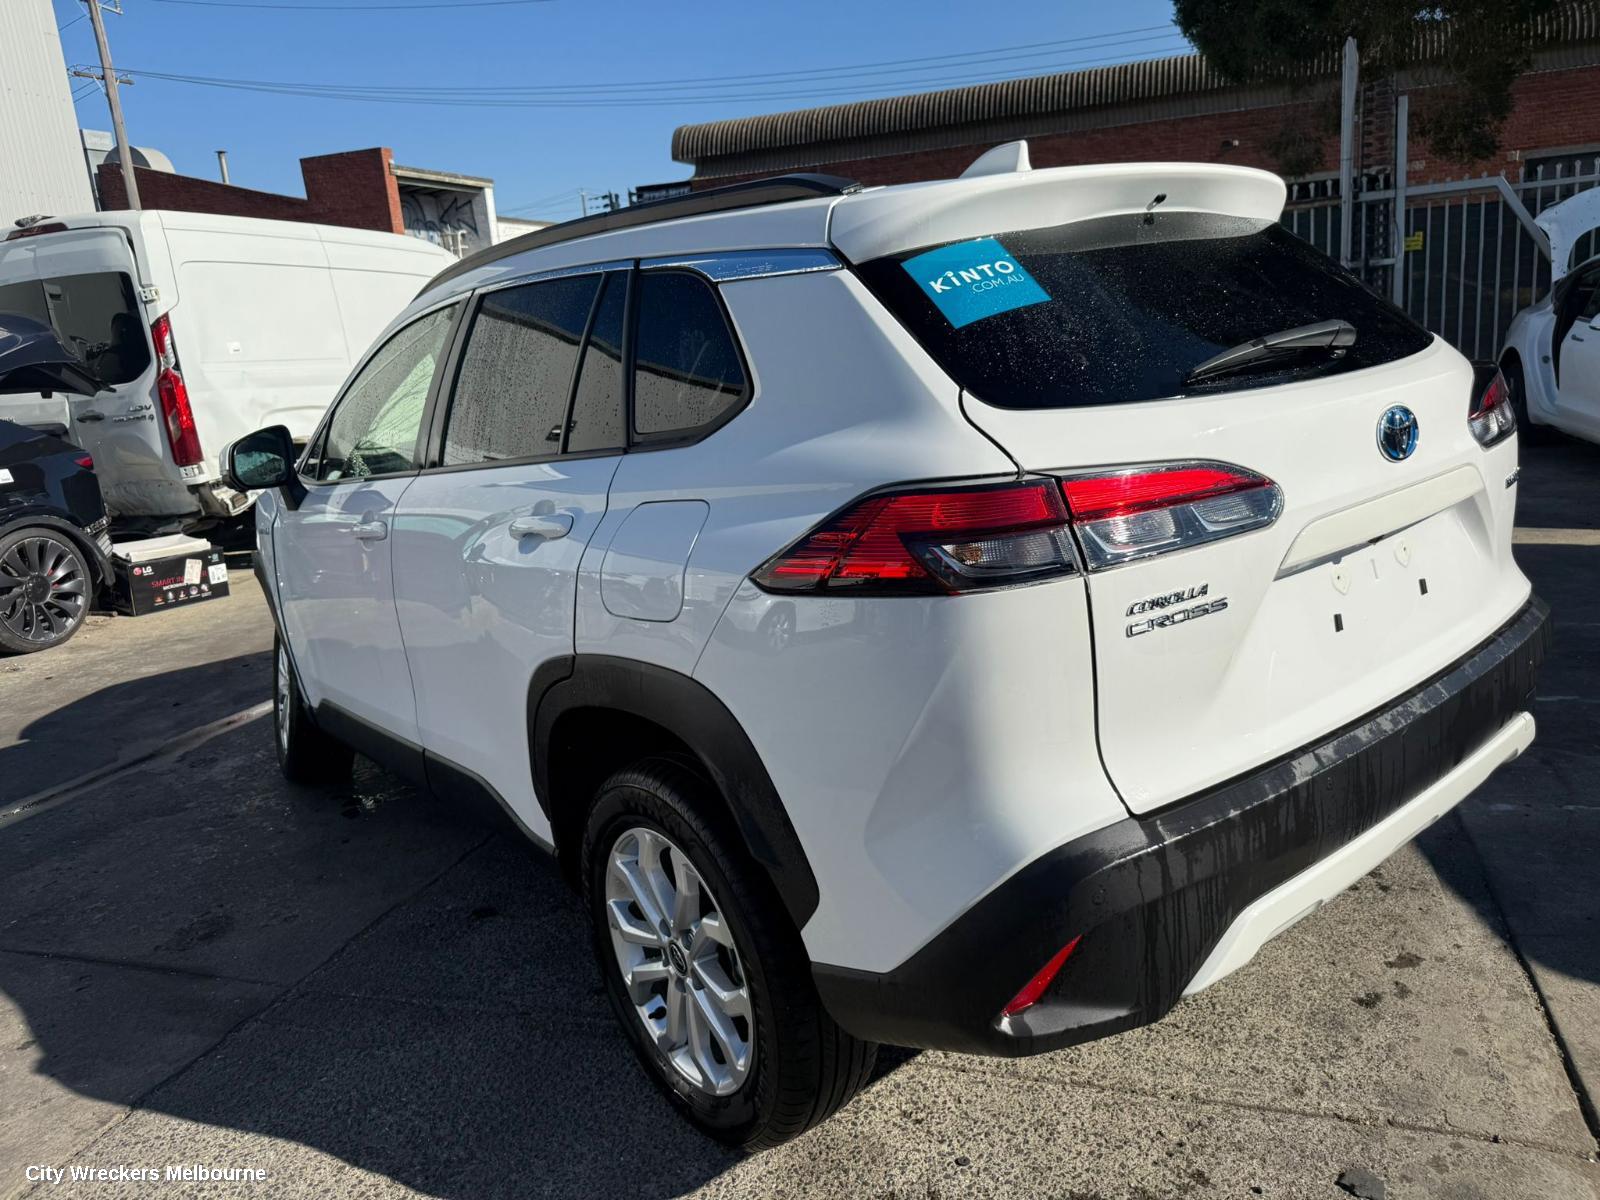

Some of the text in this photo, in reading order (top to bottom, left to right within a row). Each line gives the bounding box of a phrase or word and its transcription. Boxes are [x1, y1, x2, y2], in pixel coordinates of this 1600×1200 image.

[973, 273, 1025, 294] .COM.AU
[142, 566, 153, 574] LG
[1126, 583, 1208, 617] COROLLA
[1126, 597, 1229, 638] CROSS
